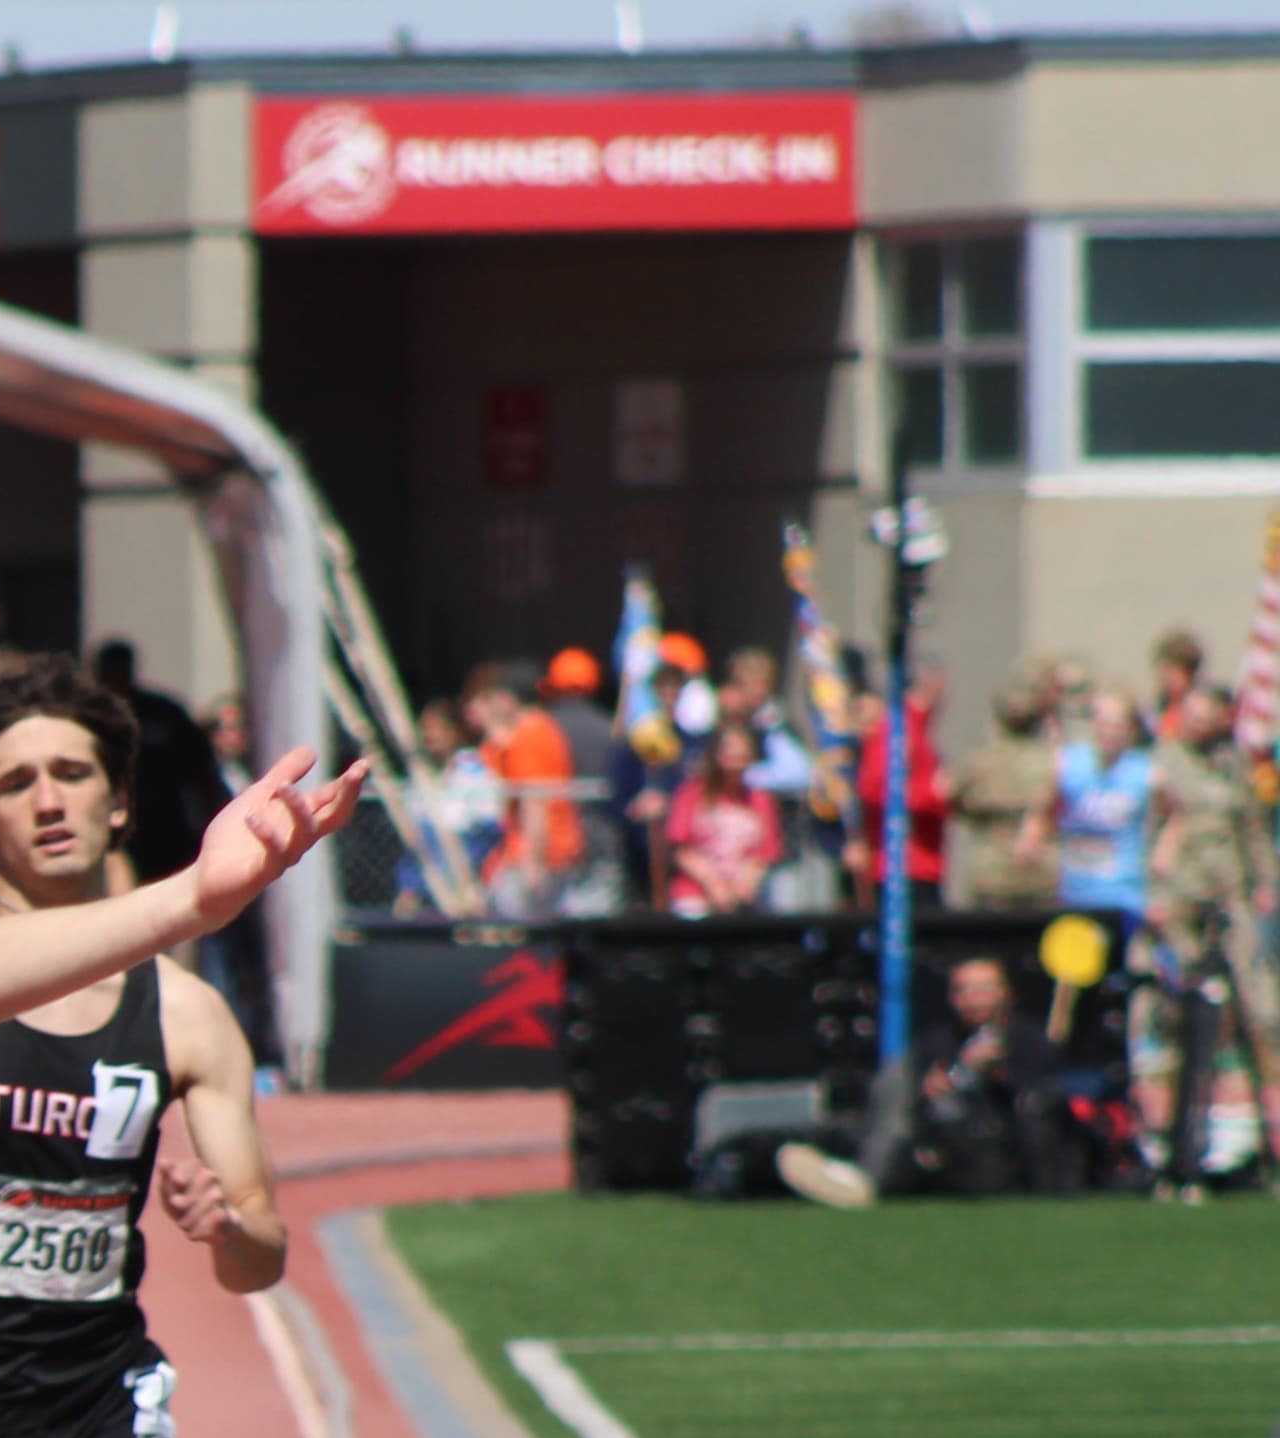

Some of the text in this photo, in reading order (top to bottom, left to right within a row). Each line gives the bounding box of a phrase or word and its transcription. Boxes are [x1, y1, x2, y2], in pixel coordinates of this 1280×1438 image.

[395, 137, 601, 187] RUNNER
[604, 135, 770, 187] CHECK
[108, 1074, 145, 1142] 7
[0, 1221, 112, 1274] 2560
